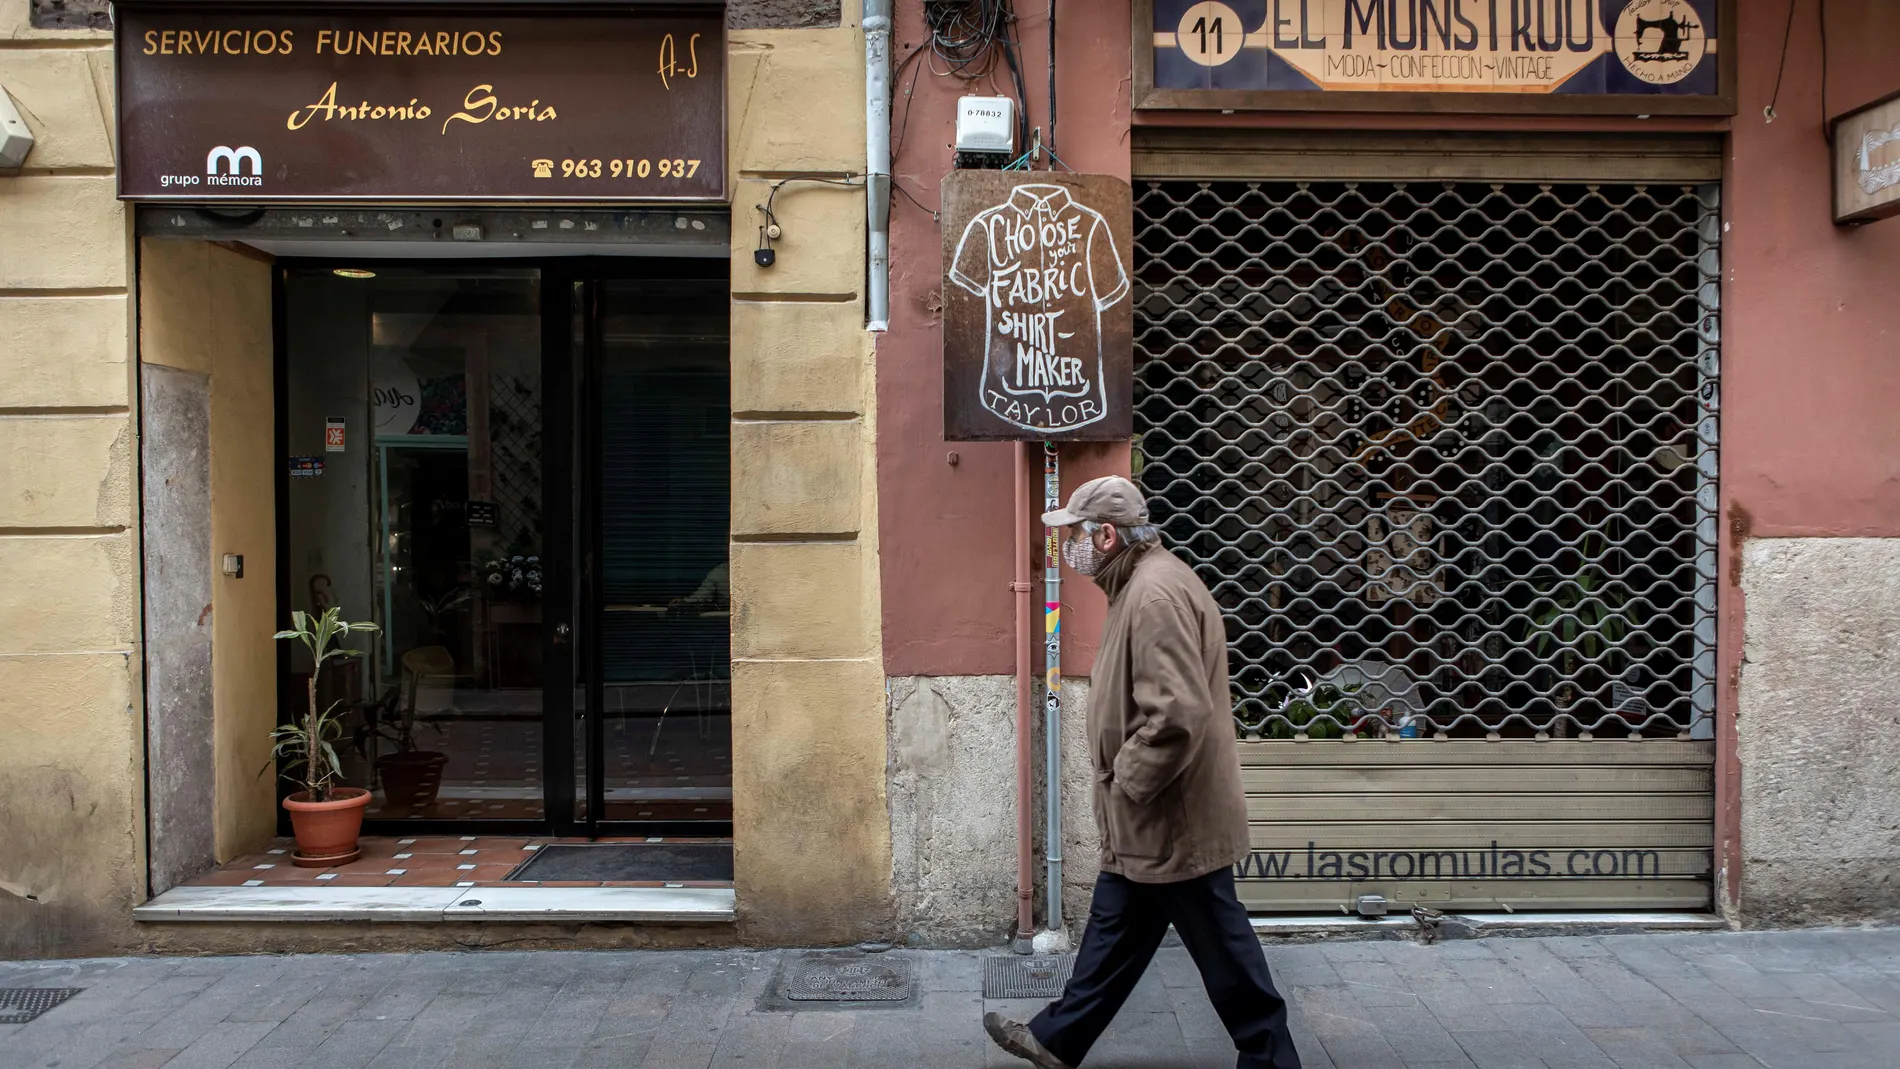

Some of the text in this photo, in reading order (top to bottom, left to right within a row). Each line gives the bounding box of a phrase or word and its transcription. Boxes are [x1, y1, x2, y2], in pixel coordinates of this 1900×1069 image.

[1191, 17, 1222, 54] 11
[1274, 0, 1326, 49] EL
[143, 30, 502, 56] SERVICIOS FUNERARIOS
[1623, 56, 1655, 82] HECHO
[1667, 63, 1692, 81] MANO
[287, 81, 557, 135] Antonio Soria
[161, 173, 262, 187] grupo mémora
[561, 159, 701, 178] 963 910 937
[990, 214, 1081, 267] CHOOSE
[1048, 239, 1078, 267] your
[1015, 342, 1088, 387] MAKER
[987, 390, 1101, 426] TAYLOR
